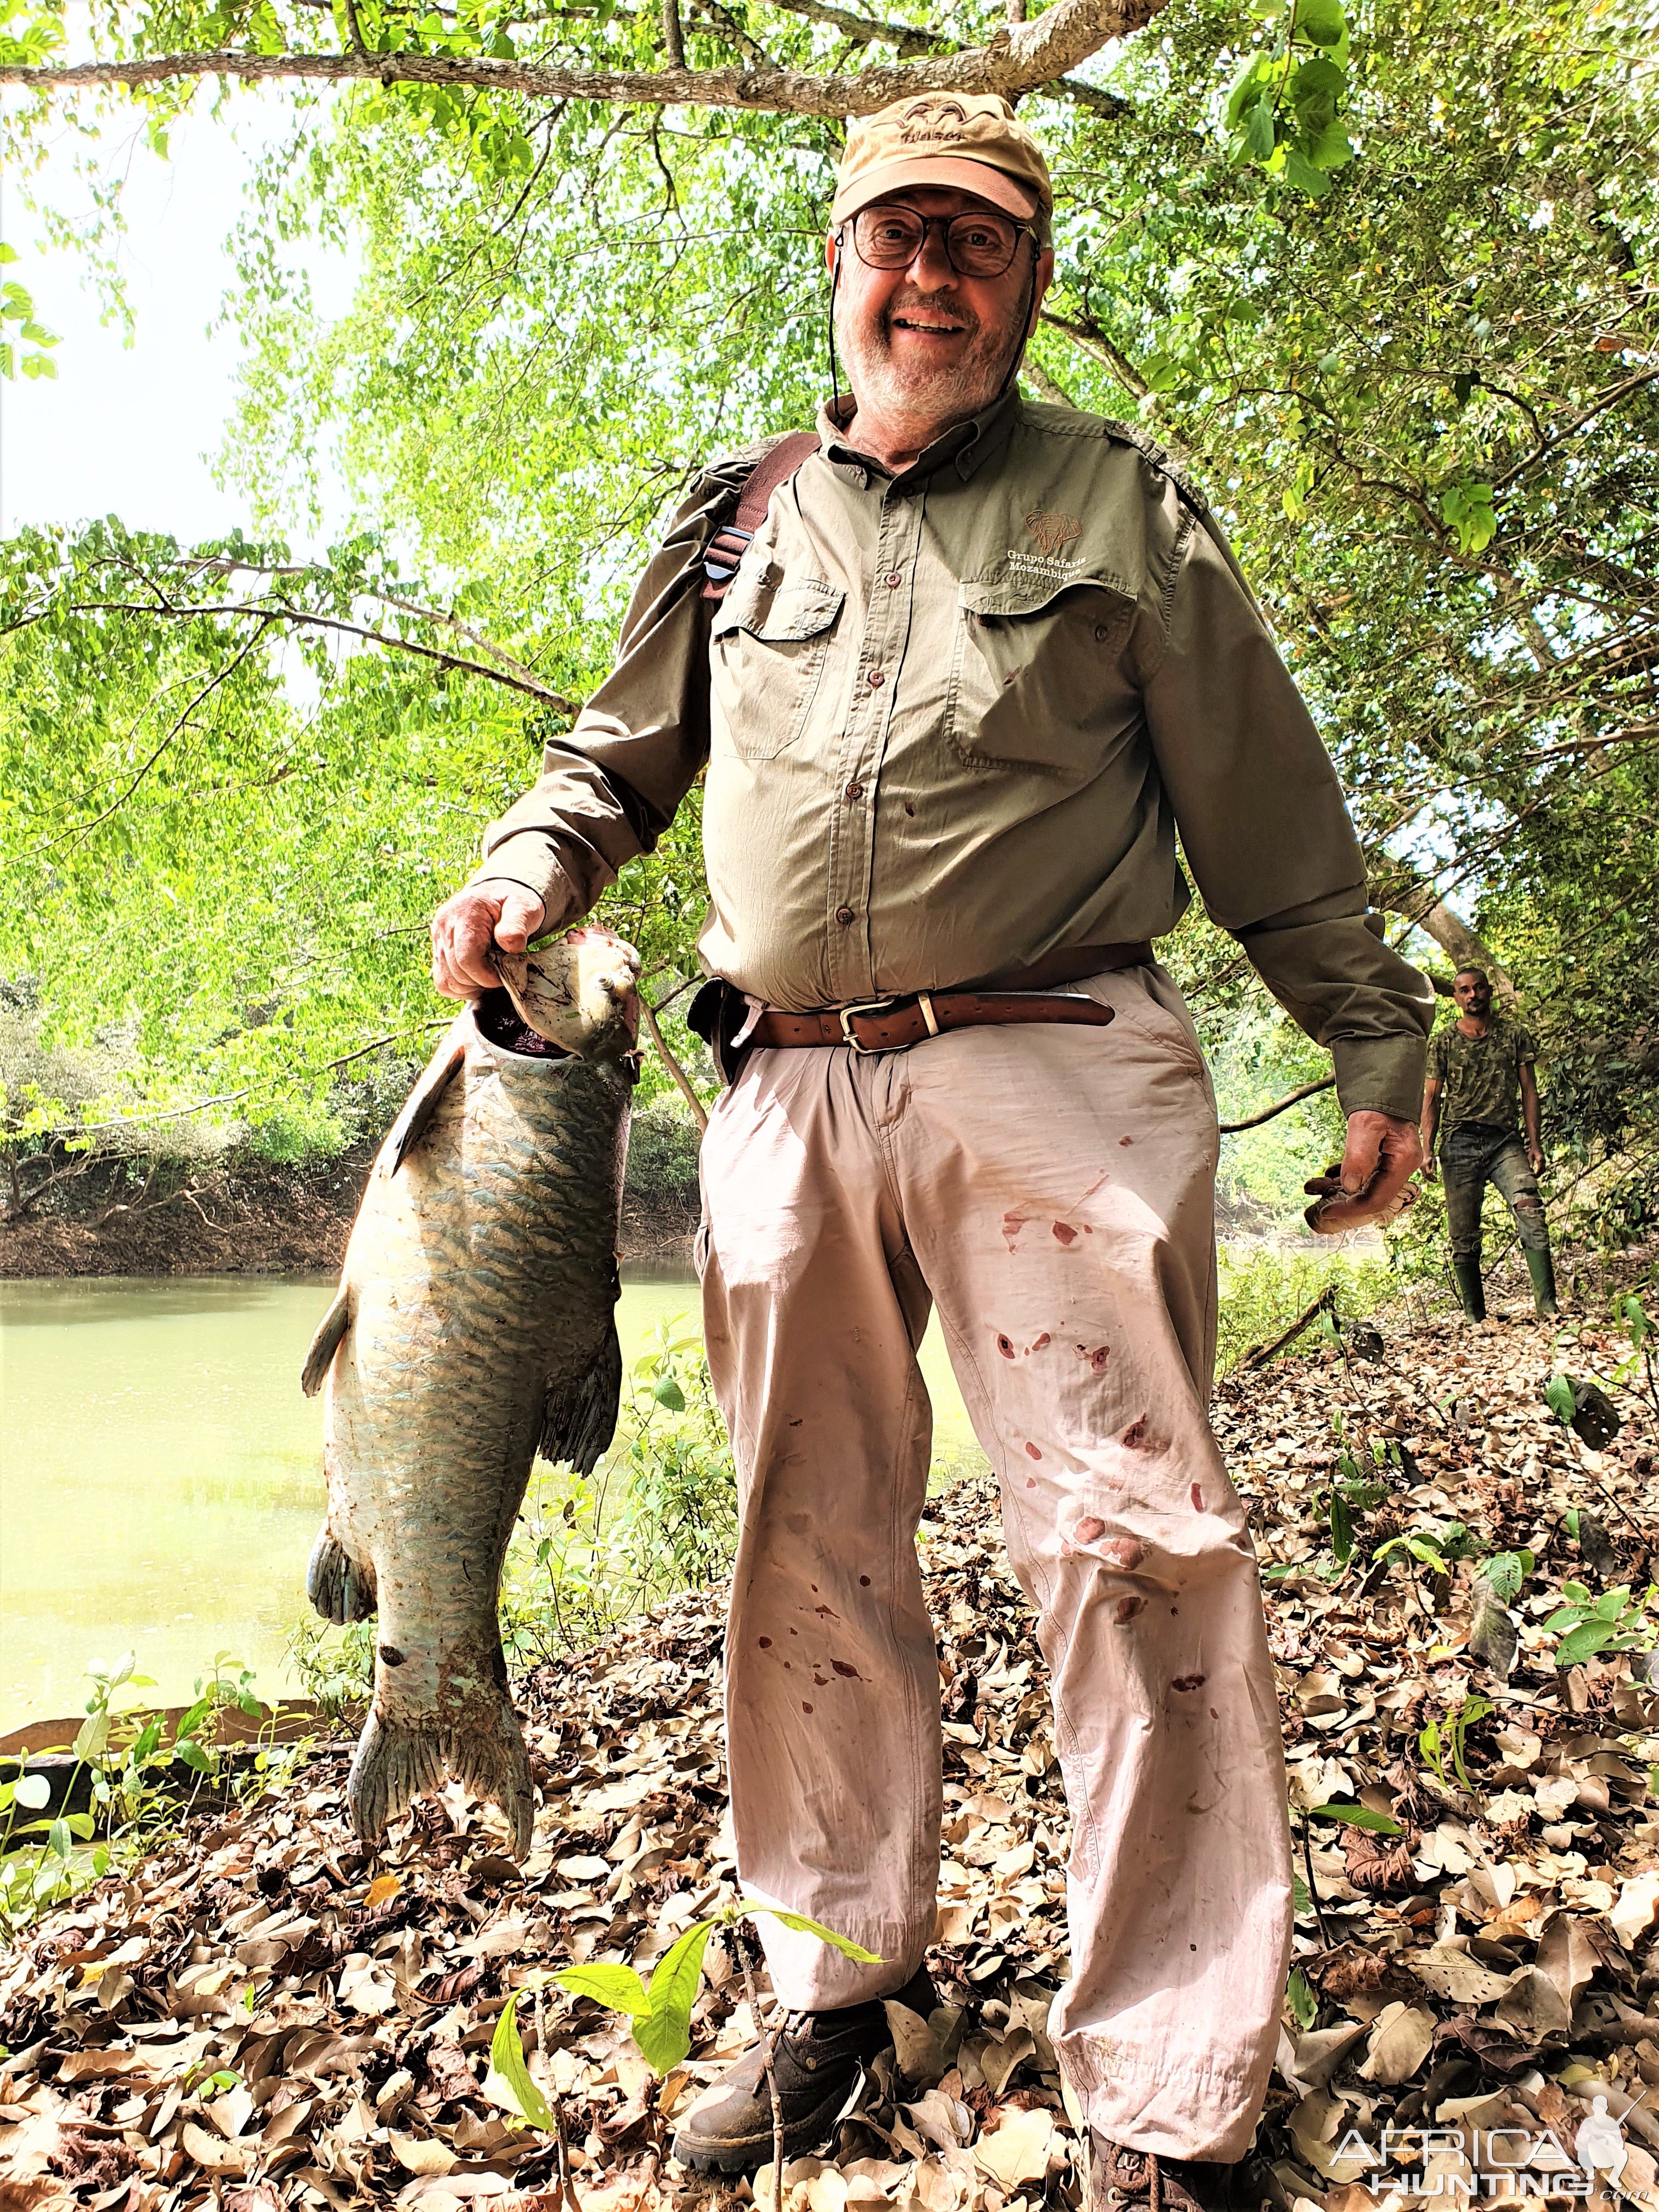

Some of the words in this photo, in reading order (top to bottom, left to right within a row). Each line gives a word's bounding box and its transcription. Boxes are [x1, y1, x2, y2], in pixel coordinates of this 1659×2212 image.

[1007, 550, 1044, 564] Grupo
[1046, 556, 1086, 568] Safaris
[1009, 562, 1081, 582] Mozambique
